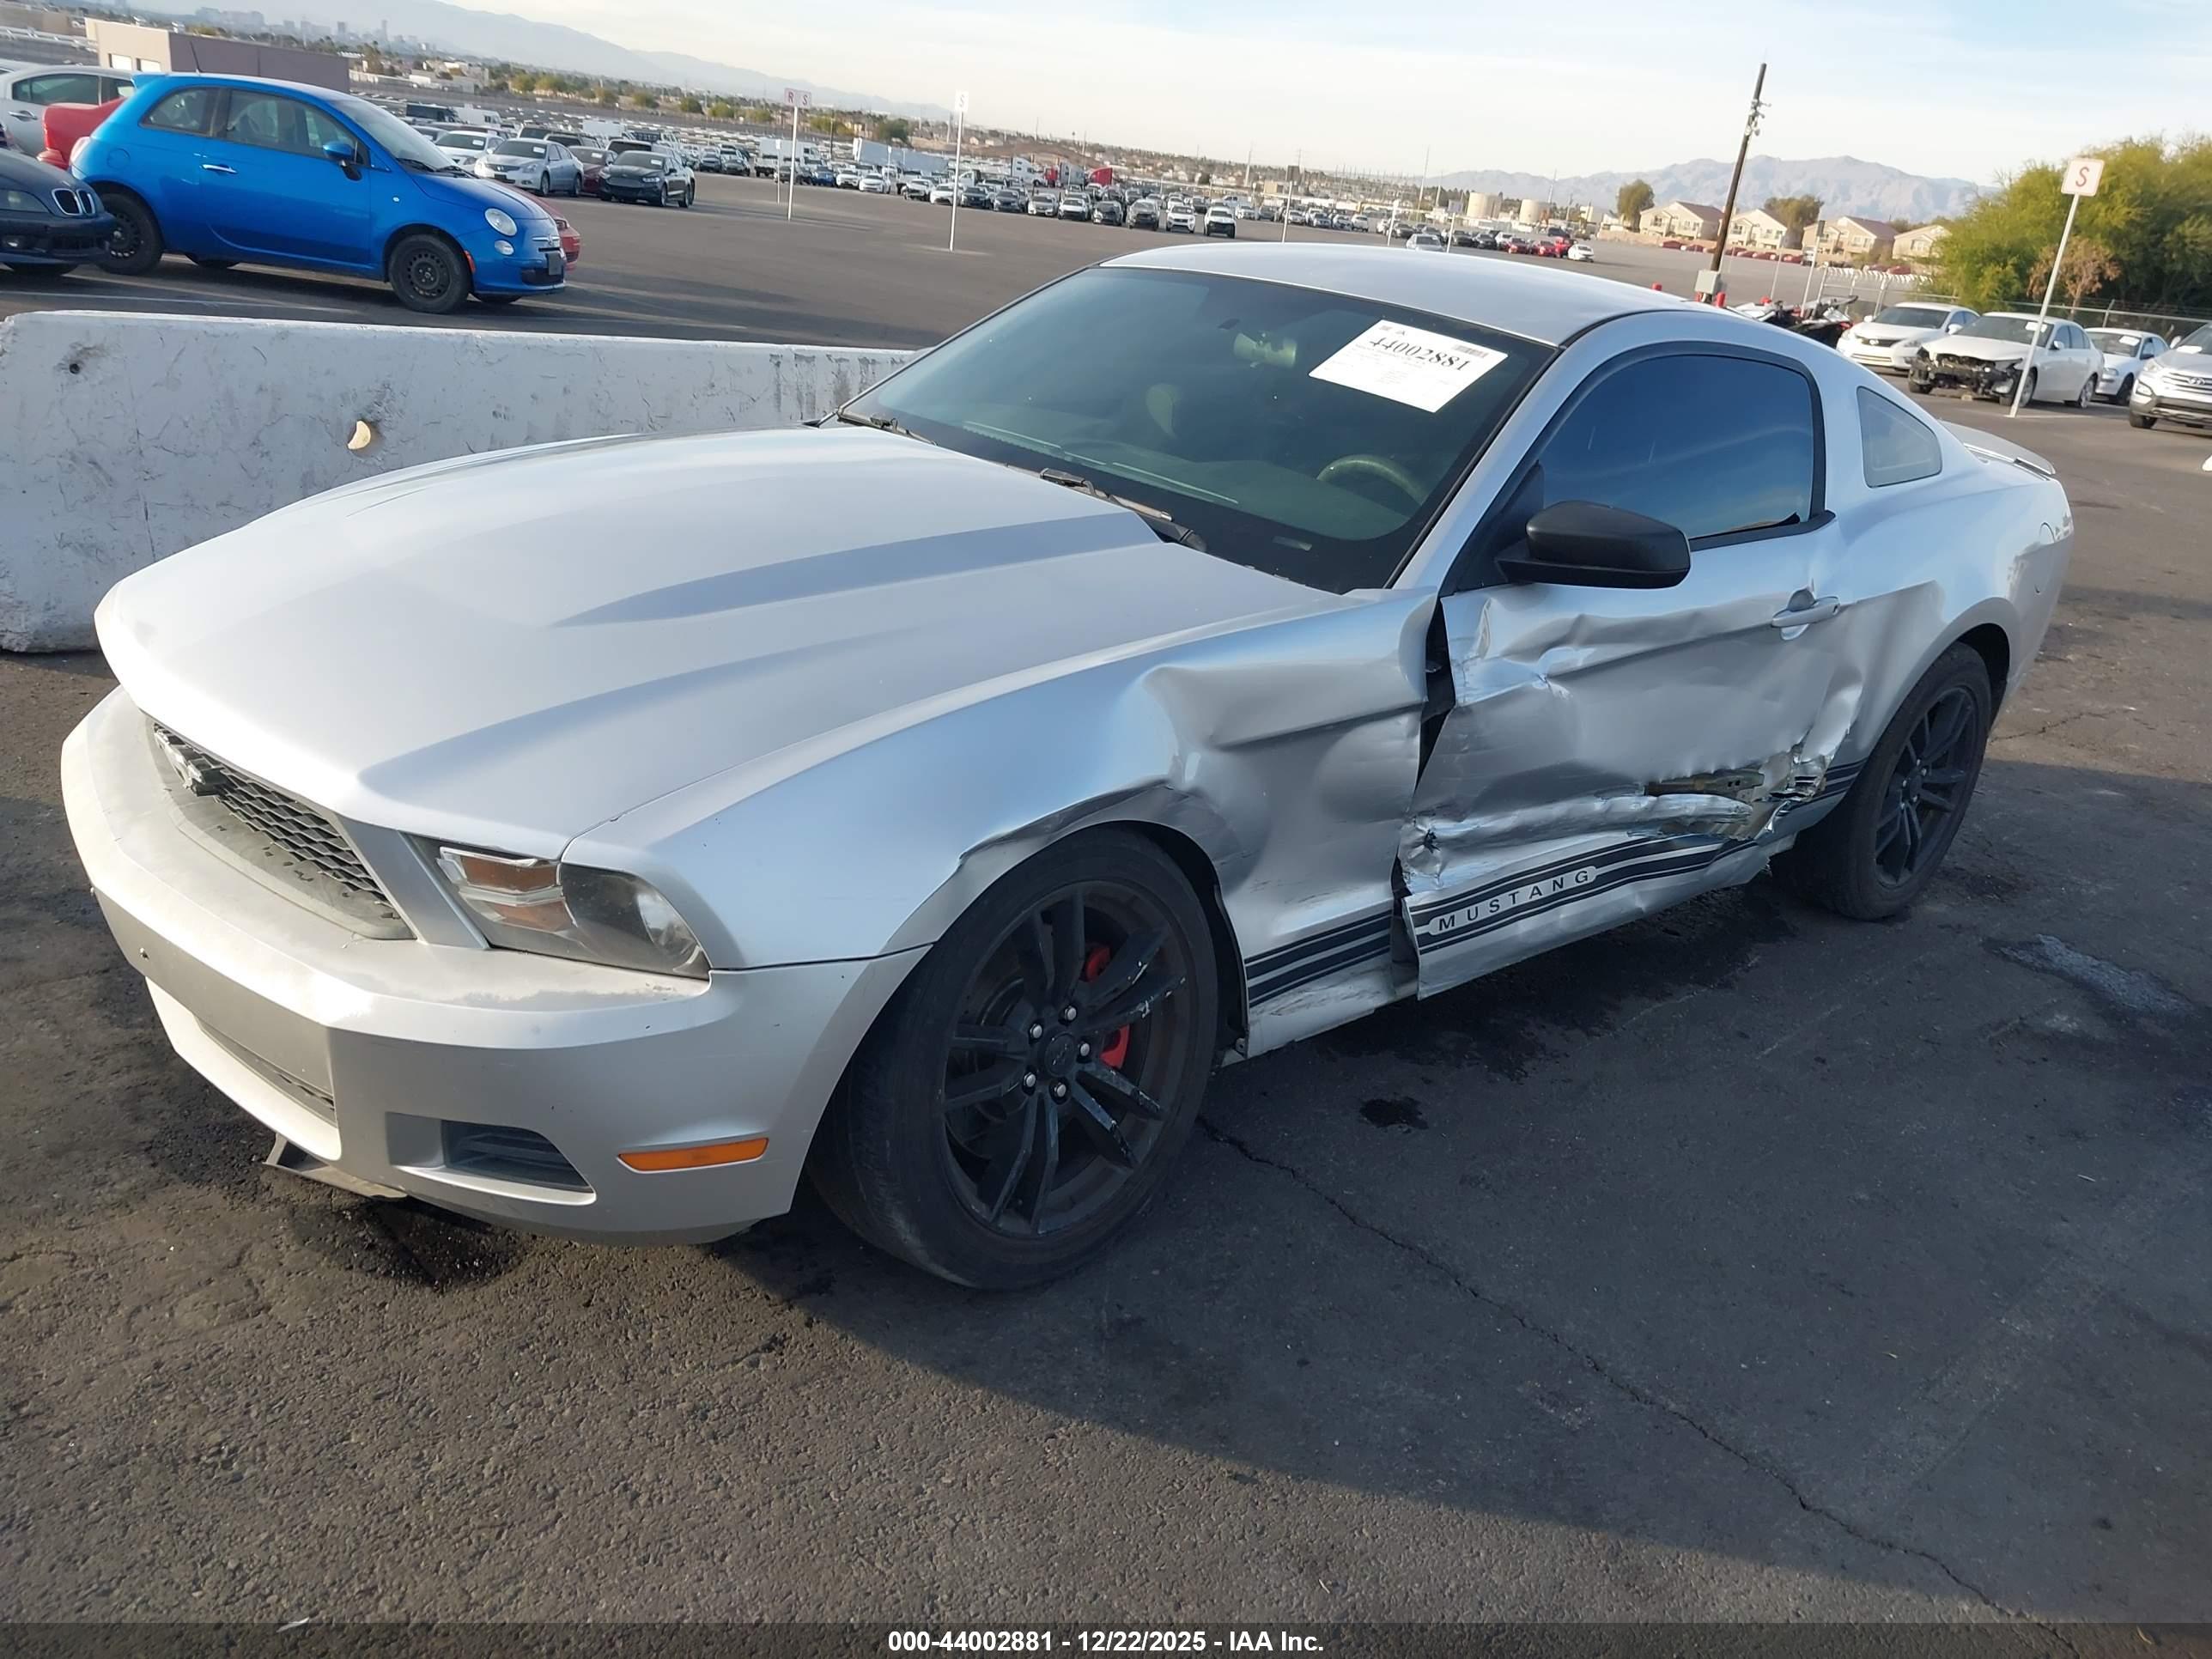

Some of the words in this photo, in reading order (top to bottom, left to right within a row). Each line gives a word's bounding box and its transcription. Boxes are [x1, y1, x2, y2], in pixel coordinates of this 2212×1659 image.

[2075, 166, 2090, 187] S
[1370, 337, 1470, 371] 44002881
[1439, 870, 1589, 931] MUSTANG
